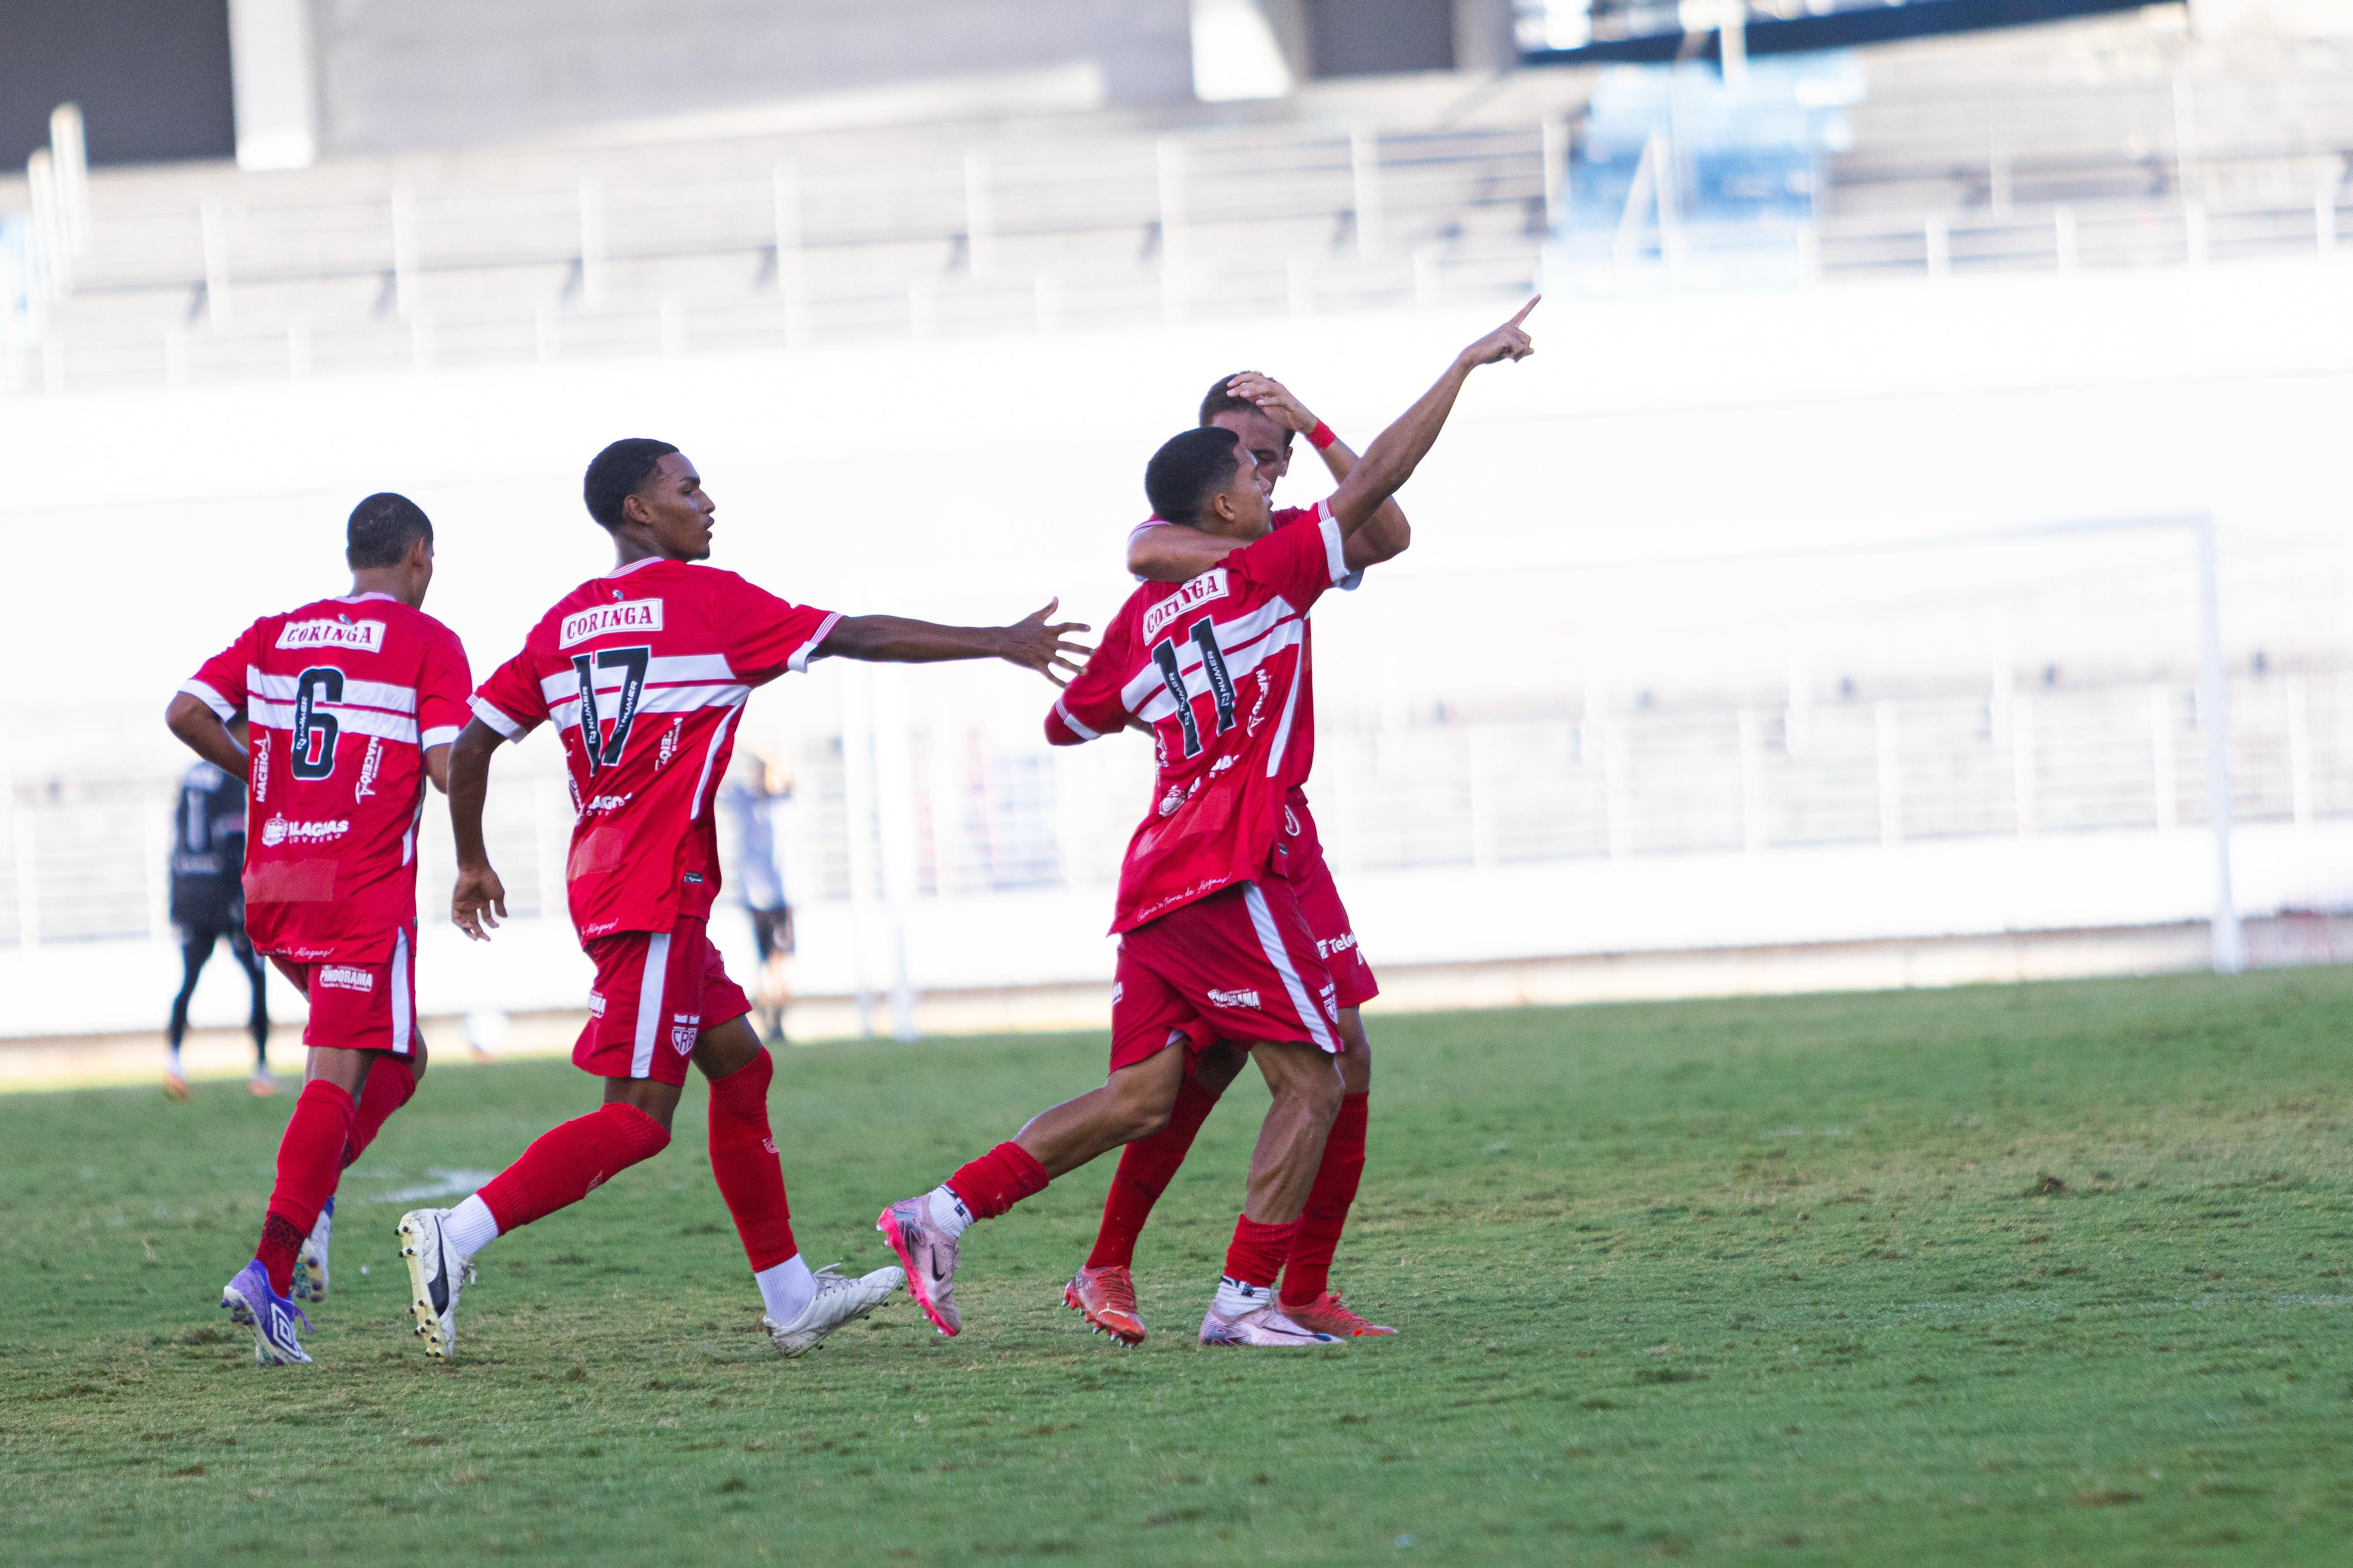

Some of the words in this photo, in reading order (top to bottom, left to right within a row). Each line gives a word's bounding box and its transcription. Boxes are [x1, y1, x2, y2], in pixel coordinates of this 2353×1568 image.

[287, 625, 372, 643] CORINGA
[567, 606, 653, 640] CORINGA
[1151, 615, 1237, 760] 11
[1207, 650, 1229, 693] NUMER
[570, 645, 650, 777] 17
[583, 686, 594, 729] NUMER
[1169, 672, 1186, 715] NUMER
[290, 666, 345, 781] 6
